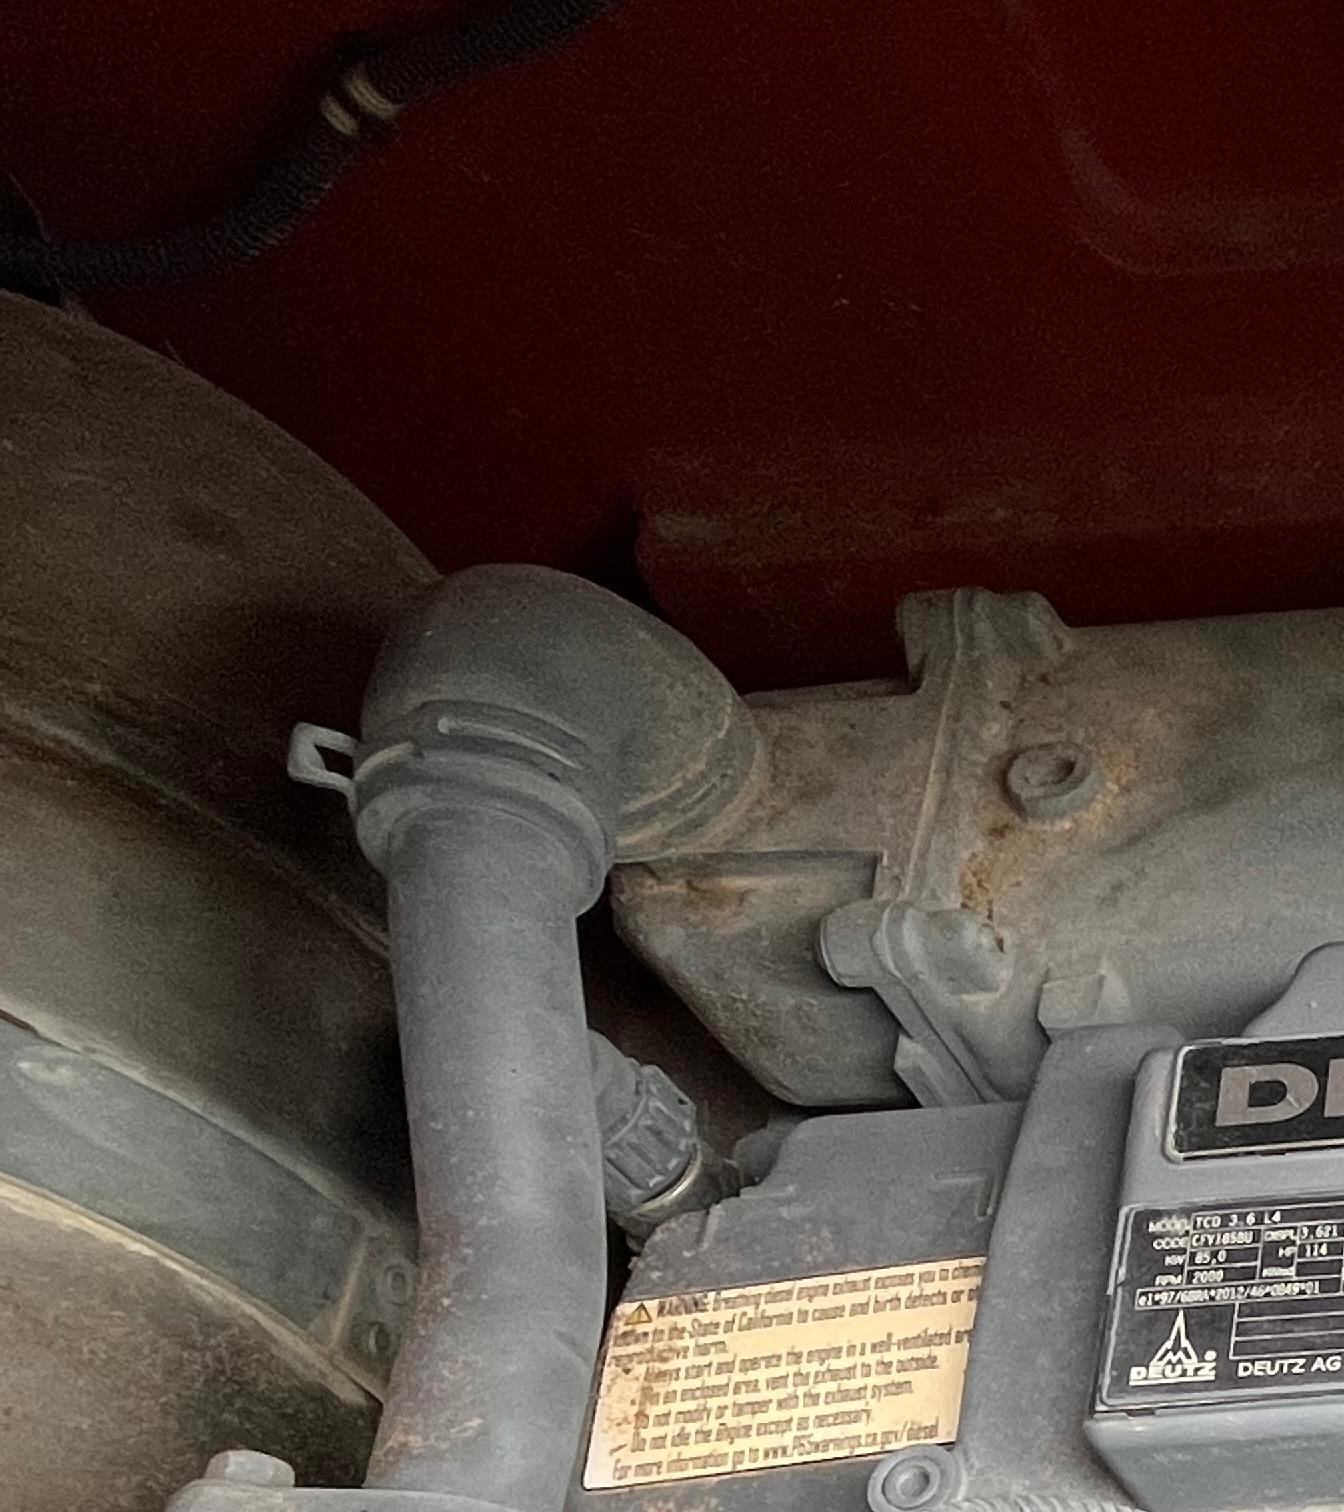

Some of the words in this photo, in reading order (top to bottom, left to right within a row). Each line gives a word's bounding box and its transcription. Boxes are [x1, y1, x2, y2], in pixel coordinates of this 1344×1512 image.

[1195, 1214, 1222, 1229] TCD
[1264, 1210, 1281, 1225] L4
[1129, 1361, 1216, 1382] DEUTZ
[1237, 1358, 1306, 1378] DEUTZ
[1311, 1355, 1342, 1373] AG
